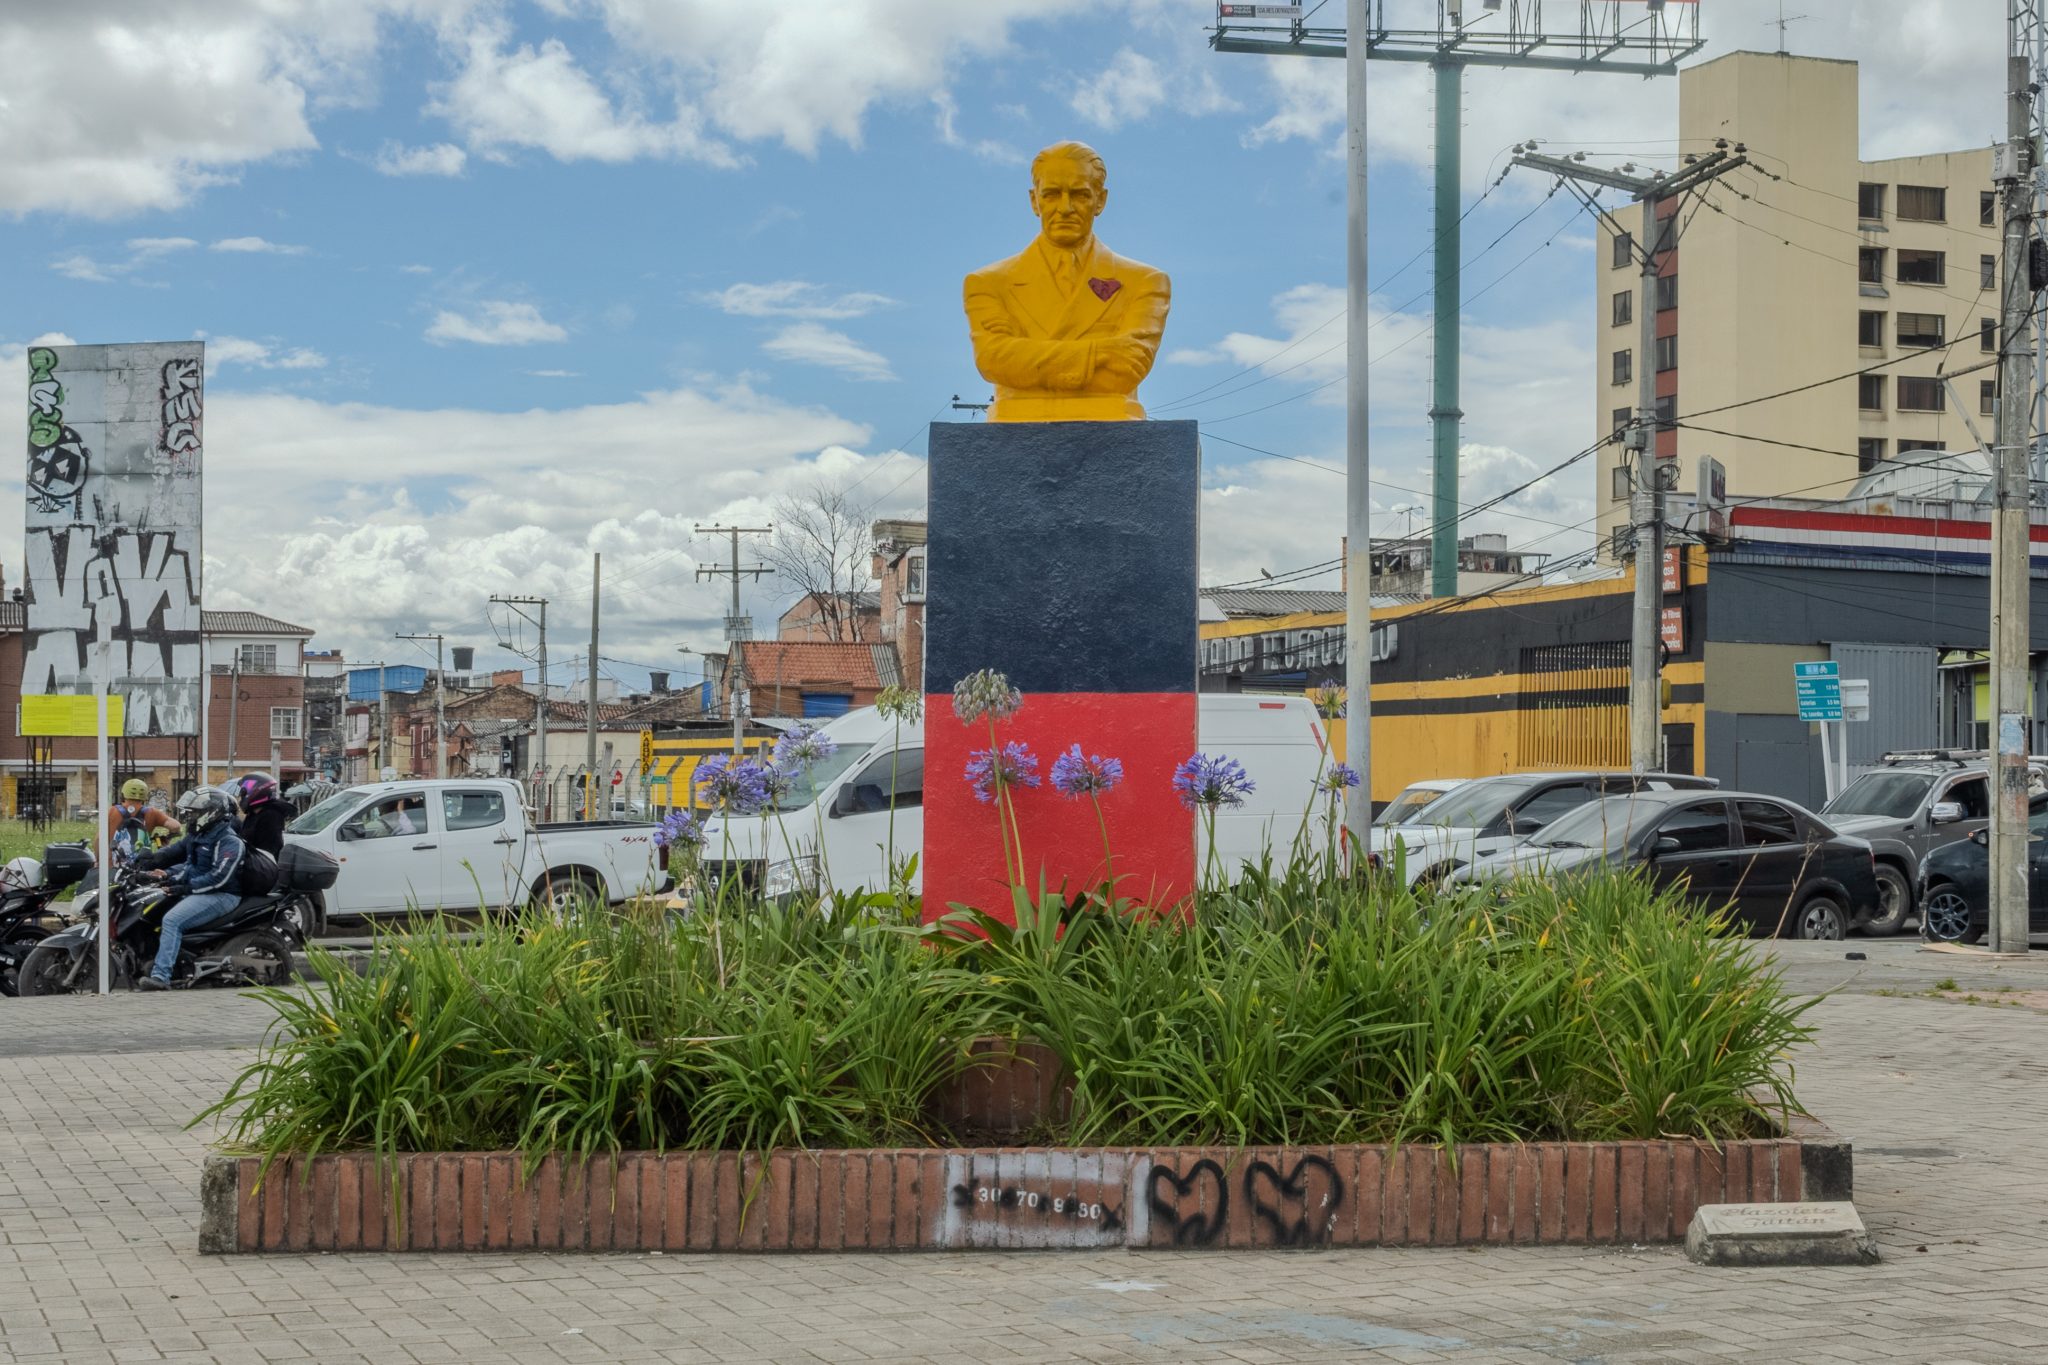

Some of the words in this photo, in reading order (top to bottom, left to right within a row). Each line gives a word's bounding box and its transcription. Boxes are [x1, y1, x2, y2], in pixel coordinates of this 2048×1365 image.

[502, 752, 510, 762] P
[978, 1187, 1002, 1203] 30
[1016, 1191, 1039, 1208] 70
[1720, 1206, 1838, 1217] Plazoleta
